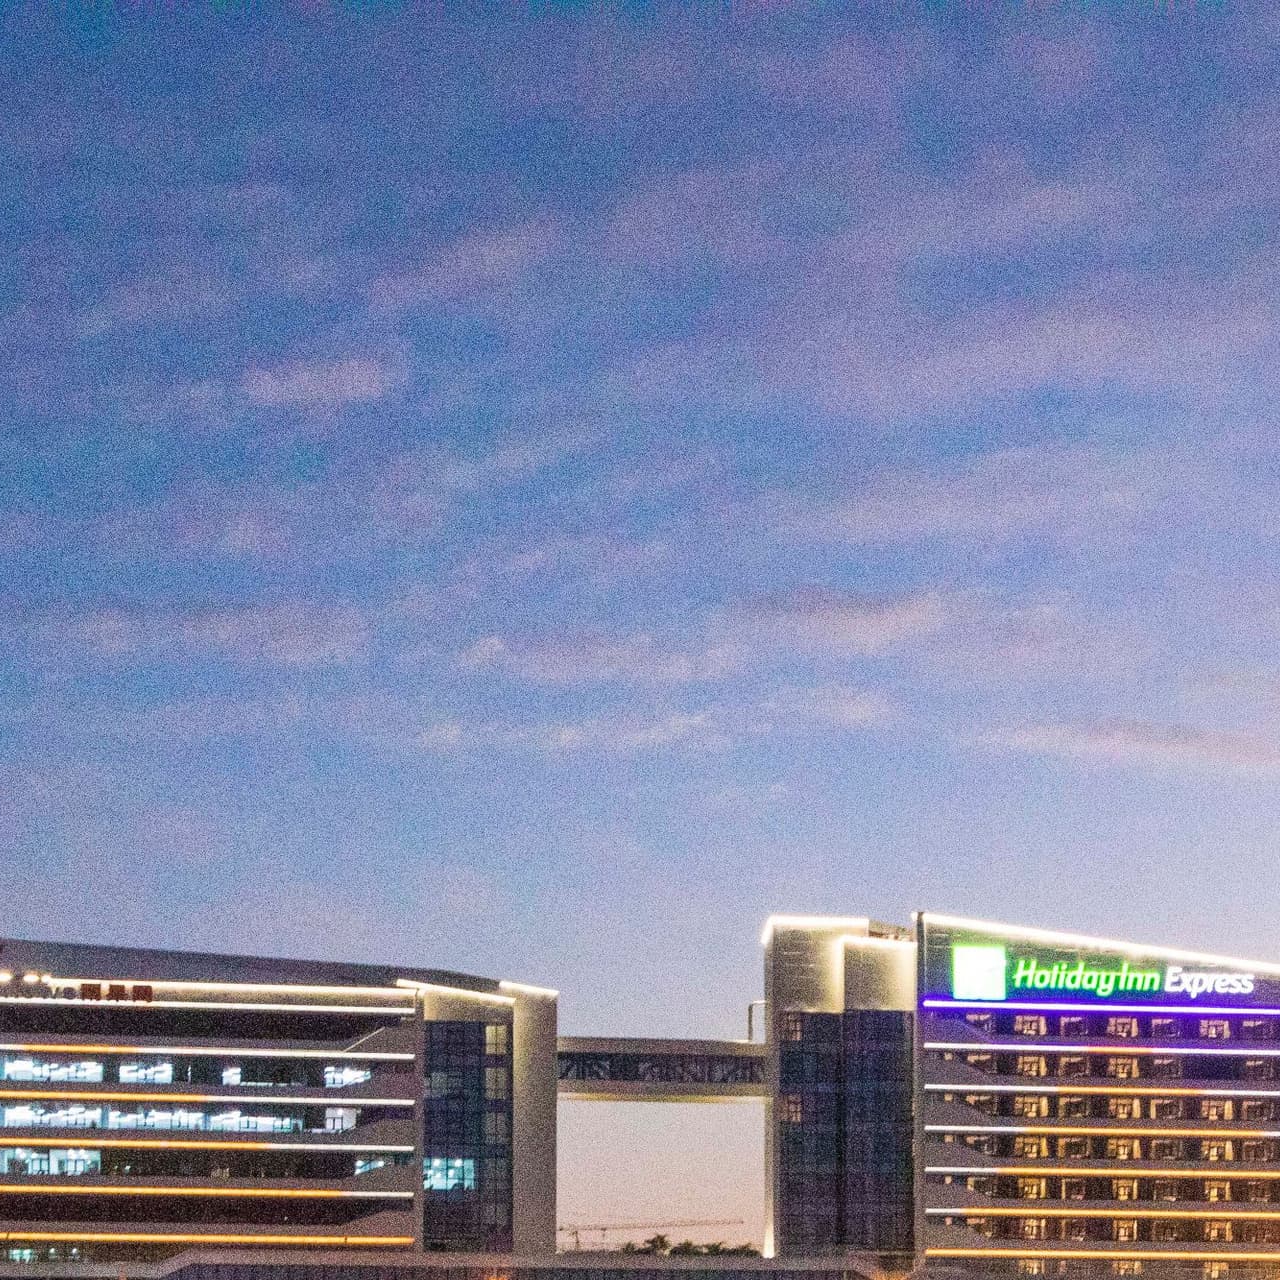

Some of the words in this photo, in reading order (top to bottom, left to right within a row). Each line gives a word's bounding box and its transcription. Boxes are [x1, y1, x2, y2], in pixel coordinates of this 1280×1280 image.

[1013, 959, 1117, 996] Holiday
[1117, 963, 1161, 991] Inn
[1164, 966, 1254, 998] Express
